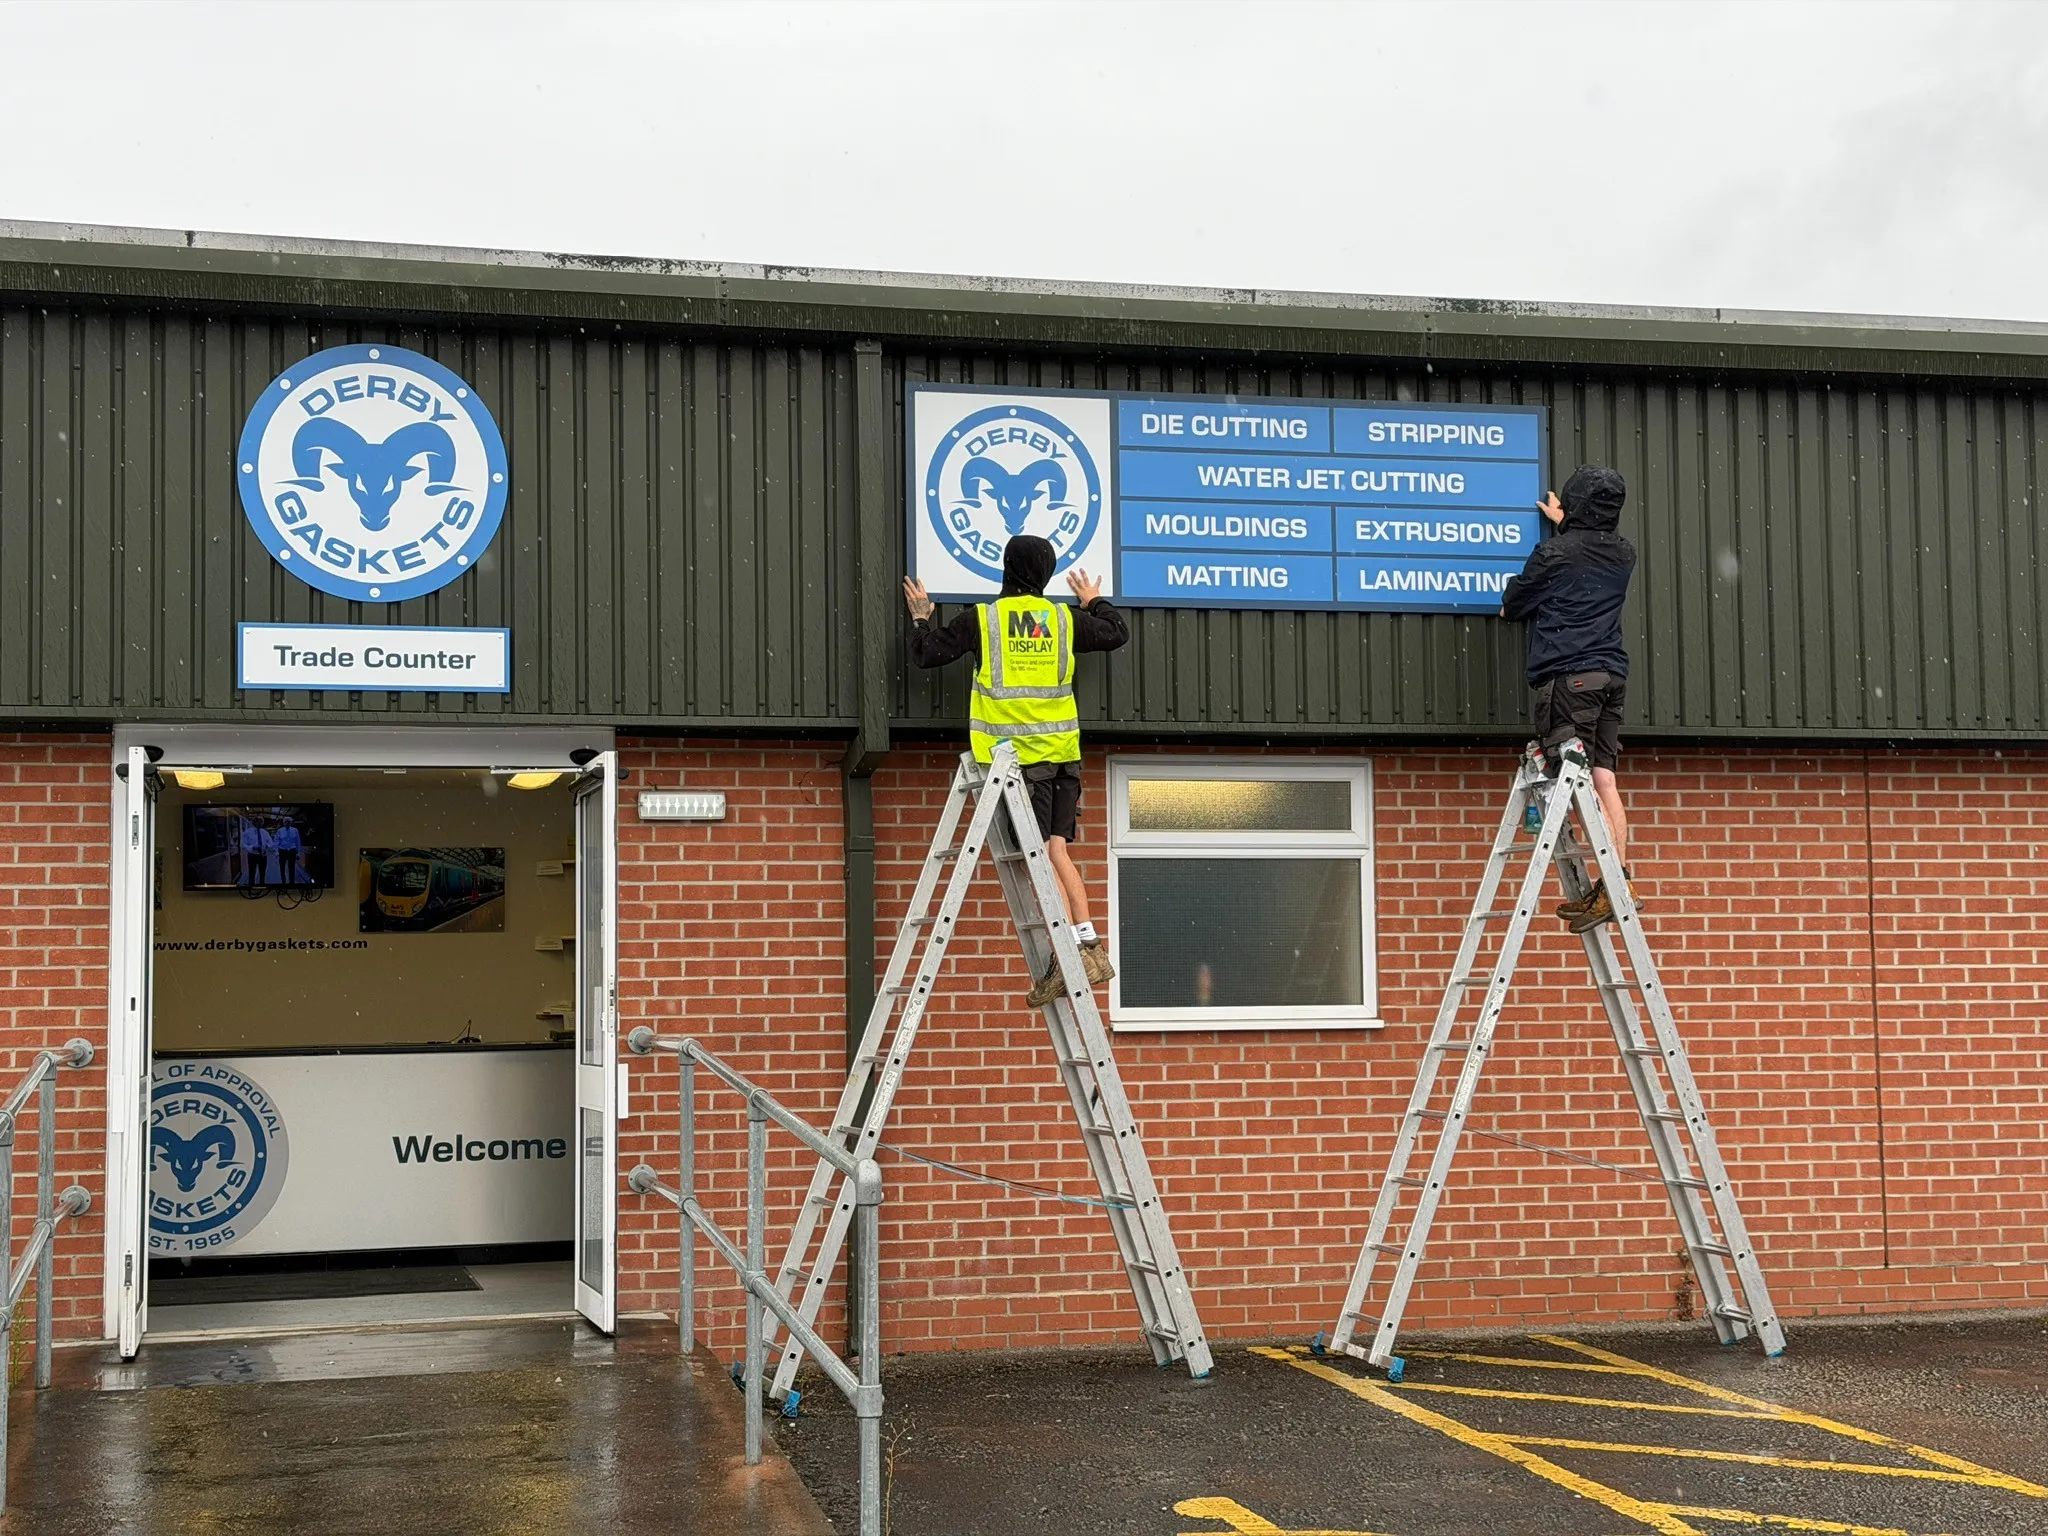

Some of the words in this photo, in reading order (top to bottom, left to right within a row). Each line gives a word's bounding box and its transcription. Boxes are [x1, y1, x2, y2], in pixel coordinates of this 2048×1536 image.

[299, 375, 458, 423] DERBY
[1141, 413, 1184, 435] DIE
[1191, 415, 1308, 439] CUTTING
[1368, 421, 1505, 446] STRIPPING
[965, 427, 1068, 459] DERBY
[1197, 465, 1290, 489] WATER
[1296, 469, 1345, 490] JET
[1351, 470, 1465, 494] CUTTING
[274, 490, 475, 575] GASKETS
[949, 507, 1080, 562] GASTS
[1145, 514, 1308, 538] MOULDINGS
[1356, 520, 1521, 544] EXTRUSIONS
[1167, 565, 1288, 588] MATTING
[1008, 610, 1053, 638] MX
[273, 645, 354, 668] Trade
[363, 647, 476, 669] Counter
[1008, 640, 1054, 653] DISPLAY
[153, 938, 368, 953] www.derbygaskets.com
[168, 1064, 195, 1078] OF
[200, 1065, 281, 1139] APPROVAL
[392, 1134, 567, 1164] Welcome
[149, 1168, 247, 1219] SKETS
[149, 1235, 177, 1251] ST.
[184, 1226, 236, 1251] 1985
